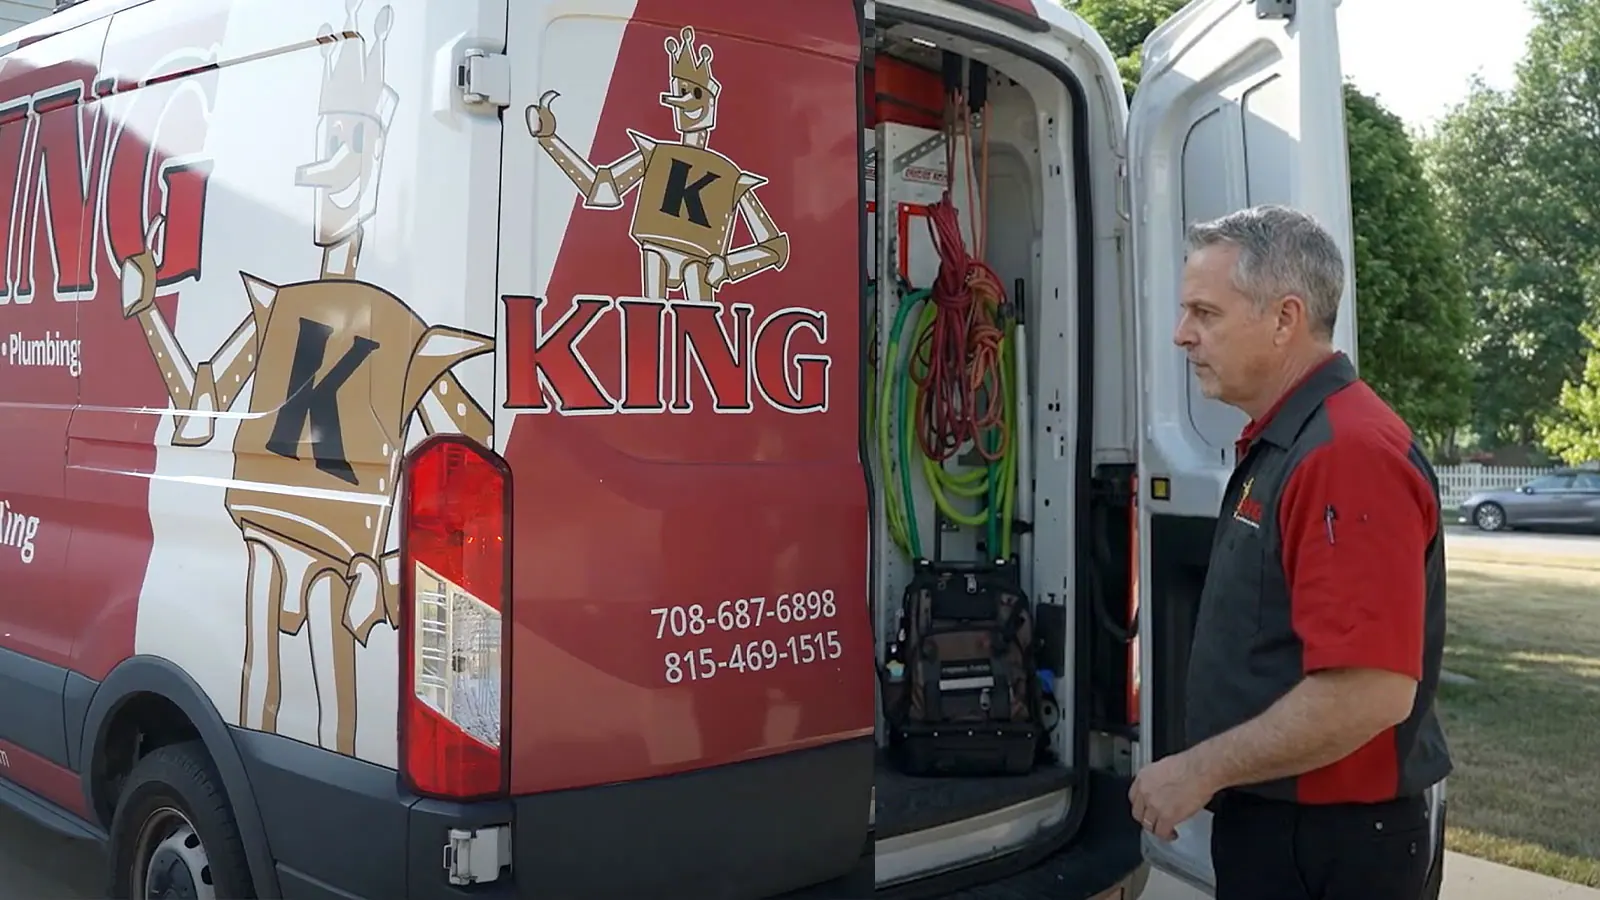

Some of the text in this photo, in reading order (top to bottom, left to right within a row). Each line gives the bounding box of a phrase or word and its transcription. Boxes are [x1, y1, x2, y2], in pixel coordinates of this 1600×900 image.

[658, 158, 723, 229] K
[9, 331, 82, 377] Plumbing
[500, 294, 832, 416] KING
[265, 318, 380, 487] K
[0, 499, 41, 564] ing
[650, 589, 837, 639] 708-687-6898
[664, 630, 843, 684] 815-469-1515
